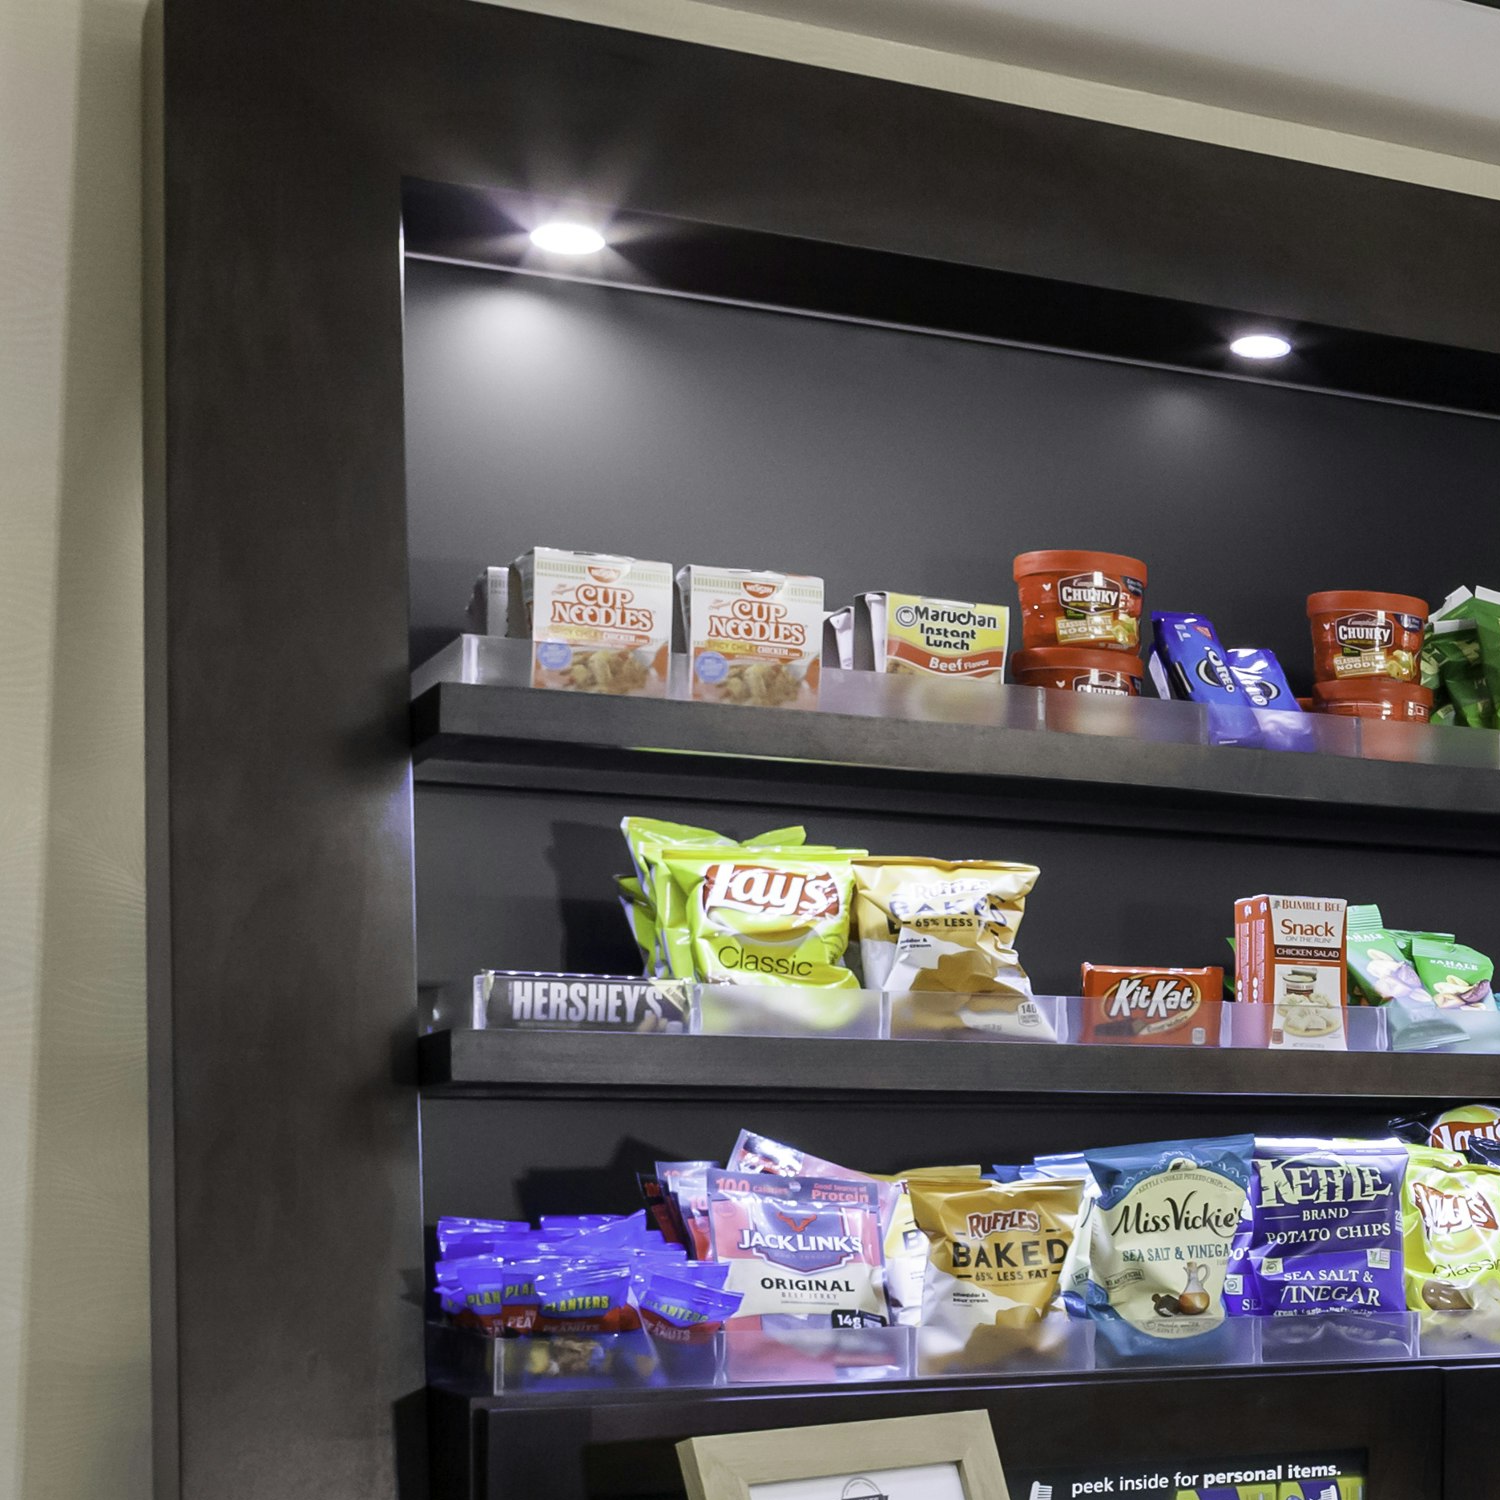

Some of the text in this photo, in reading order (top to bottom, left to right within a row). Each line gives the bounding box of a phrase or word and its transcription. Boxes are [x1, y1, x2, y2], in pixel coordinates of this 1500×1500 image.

[575, 584, 634, 609] CUP
[1062, 586, 1119, 606] CHUNKY
[551, 601, 653, 632] NOODLES
[731, 599, 788, 623] CUP
[914, 605, 997, 629] Maruchan
[708, 615, 806, 645] NOODLES
[920, 623, 977, 640] Instant
[1339, 625, 1391, 642] CHUNKY
[925, 636, 970, 651] Lunch
[929, 657, 963, 673] Beef
[1206, 649, 1236, 694] OREO
[704, 864, 840, 917] Lay's
[1282, 899, 1341, 912] BUMBLE BEE
[915, 918, 939, 928] 65%
[944, 918, 973, 927] LESS
[1281, 919, 1335, 937] Snack
[718, 945, 813, 977] Classic
[1276, 948, 1339, 959] CHICKEN SALAD
[512, 981, 663, 1024] HERSHEY'S
[716, 1177, 750, 1193] 100
[1255, 1159, 1393, 1208] KETTLE
[811, 1189, 869, 1203] Protein
[967, 1209, 1041, 1238] RUFFLES
[1112, 1201, 1170, 1236] Miss
[1303, 1207, 1349, 1222] BRAND
[739, 1229, 862, 1252] JACK LINK'S
[1266, 1223, 1392, 1244] POTATO CHIPS
[952, 1239, 1068, 1269] BAKED
[1123, 1250, 1145, 1262] SEA
[1147, 1248, 1171, 1261] SALT
[1174, 1247, 1185, 1260] &
[1187, 1243, 1230, 1259] VINEGA
[760, 1277, 855, 1292] ORIGINAL
[975, 1269, 1049, 1282] 65% LESS FAT
[1284, 1269, 1374, 1283] SEA SALT &
[1280, 1285, 1381, 1307] VINEGAR
[836, 1313, 862, 1330] 14g
[1072, 1463, 1341, 1498] peek inside for personal items.
